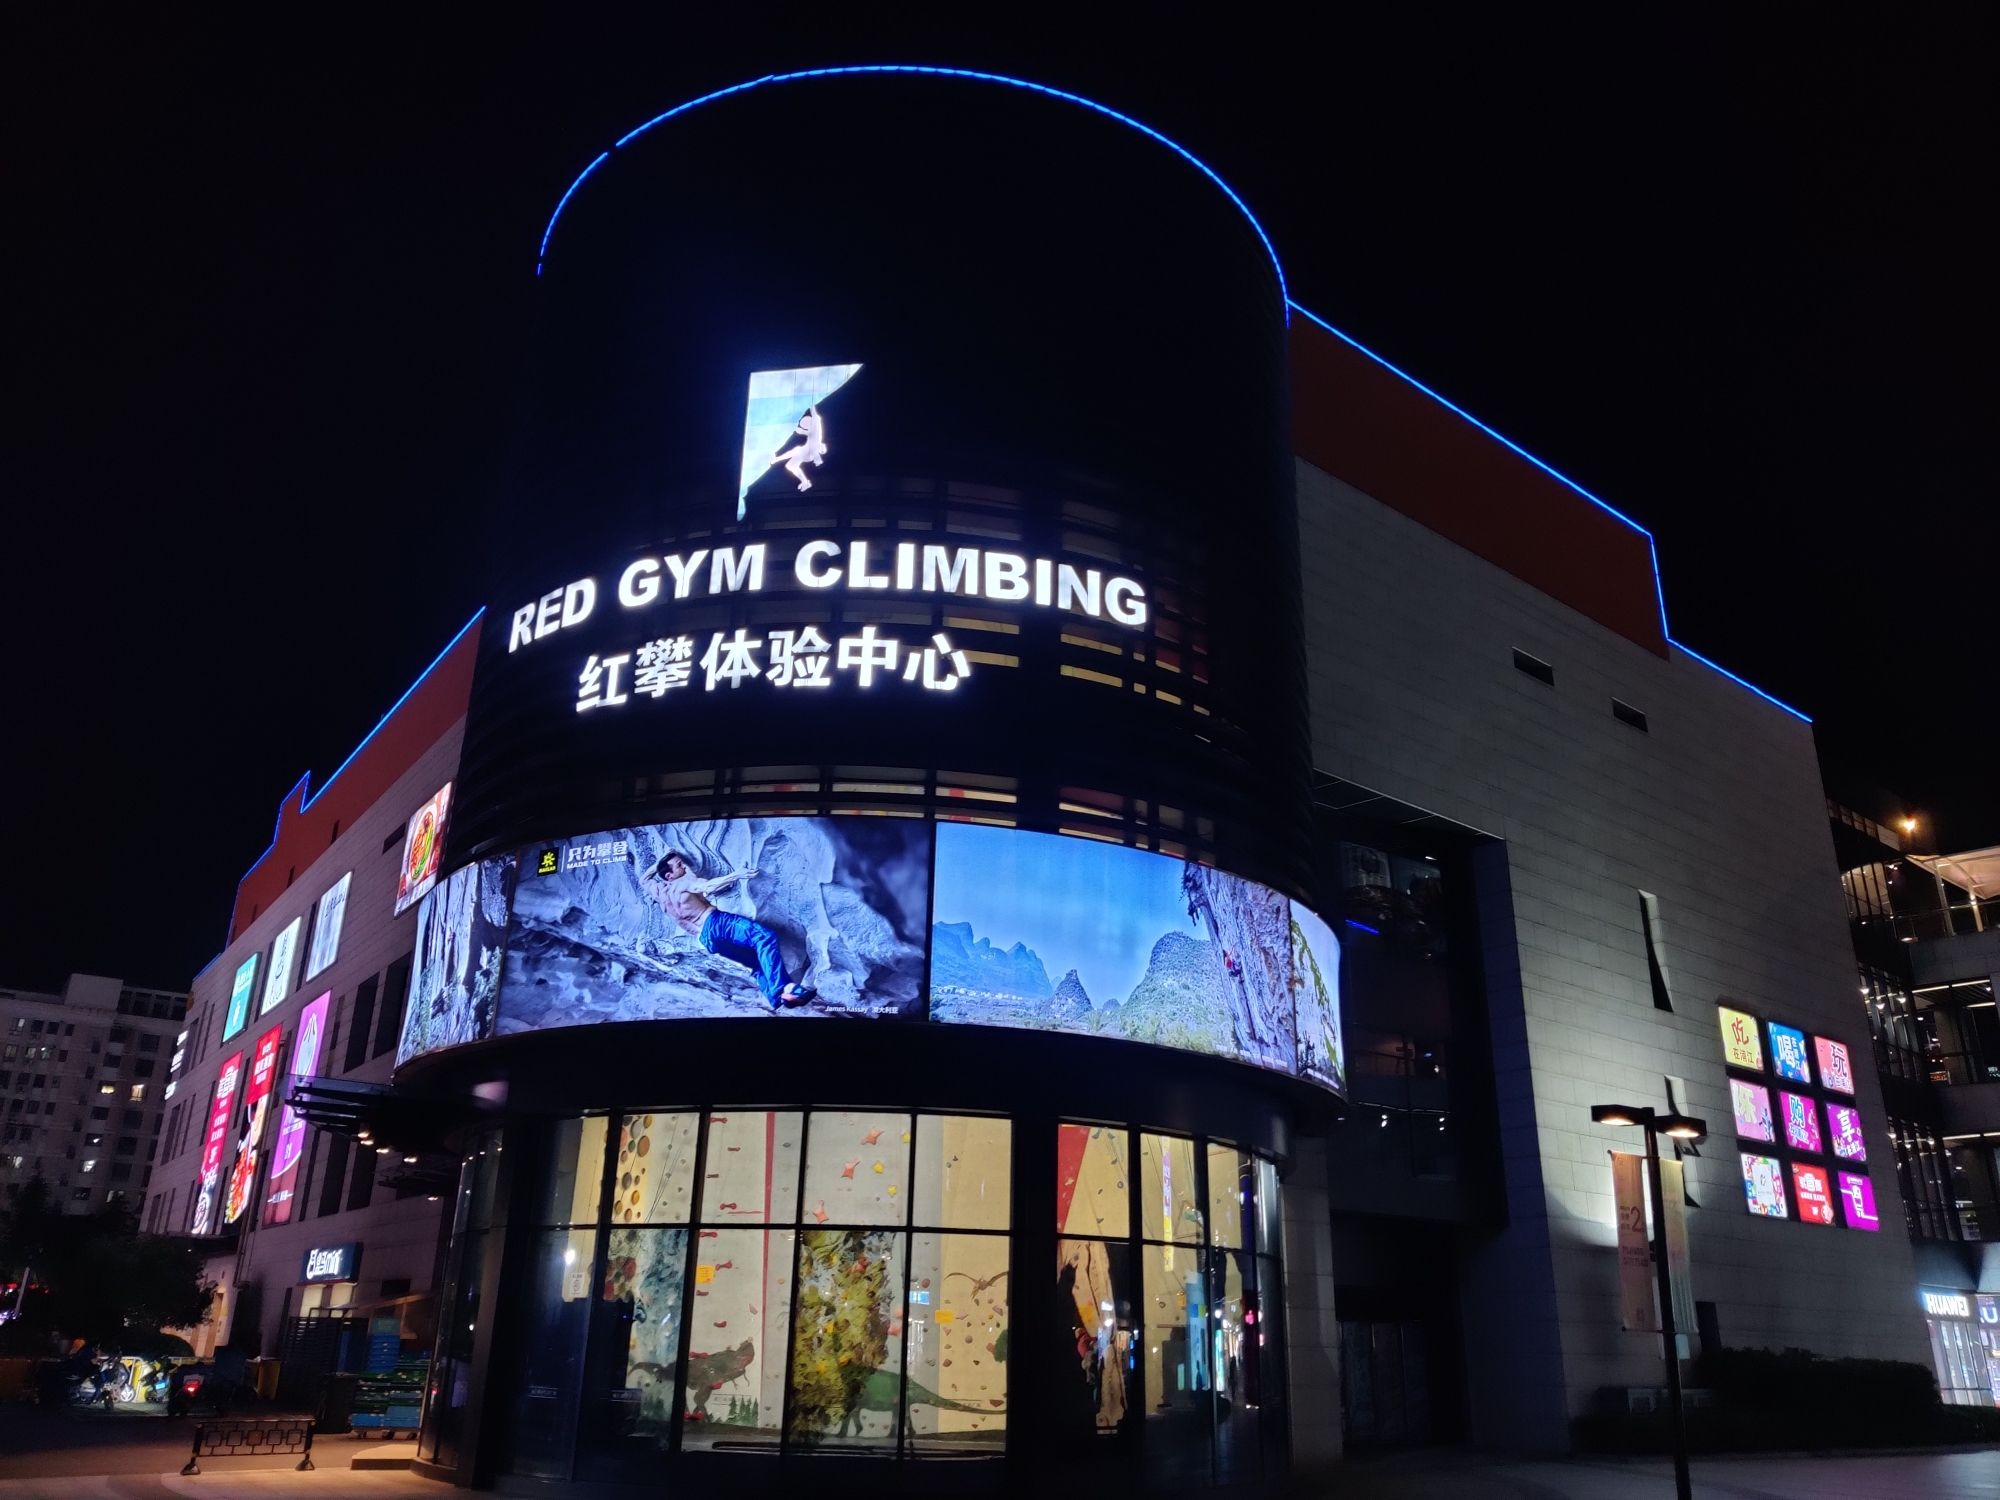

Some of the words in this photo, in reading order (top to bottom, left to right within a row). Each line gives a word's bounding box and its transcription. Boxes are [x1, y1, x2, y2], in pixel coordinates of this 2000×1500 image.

[509, 578, 597, 653] RED
[618, 543, 765, 608] GYM
[794, 540, 1147, 626] CLIMBING
[576, 626, 971, 712] 红攀体验中心
[566, 861, 588, 869] MADE
[567, 840, 628, 862] 只为攀登
[846, 1006, 869, 1014] Kassay
[1731, 1018, 1749, 1045] 吃
[1776, 1034, 1796, 1069] 喝
[1830, 1042, 1848, 1077] 玩
[1789, 1095, 1806, 1128] 购
[1836, 1109, 1856, 1142] 享
[1927, 1294, 1970, 1317] HUAWEI
